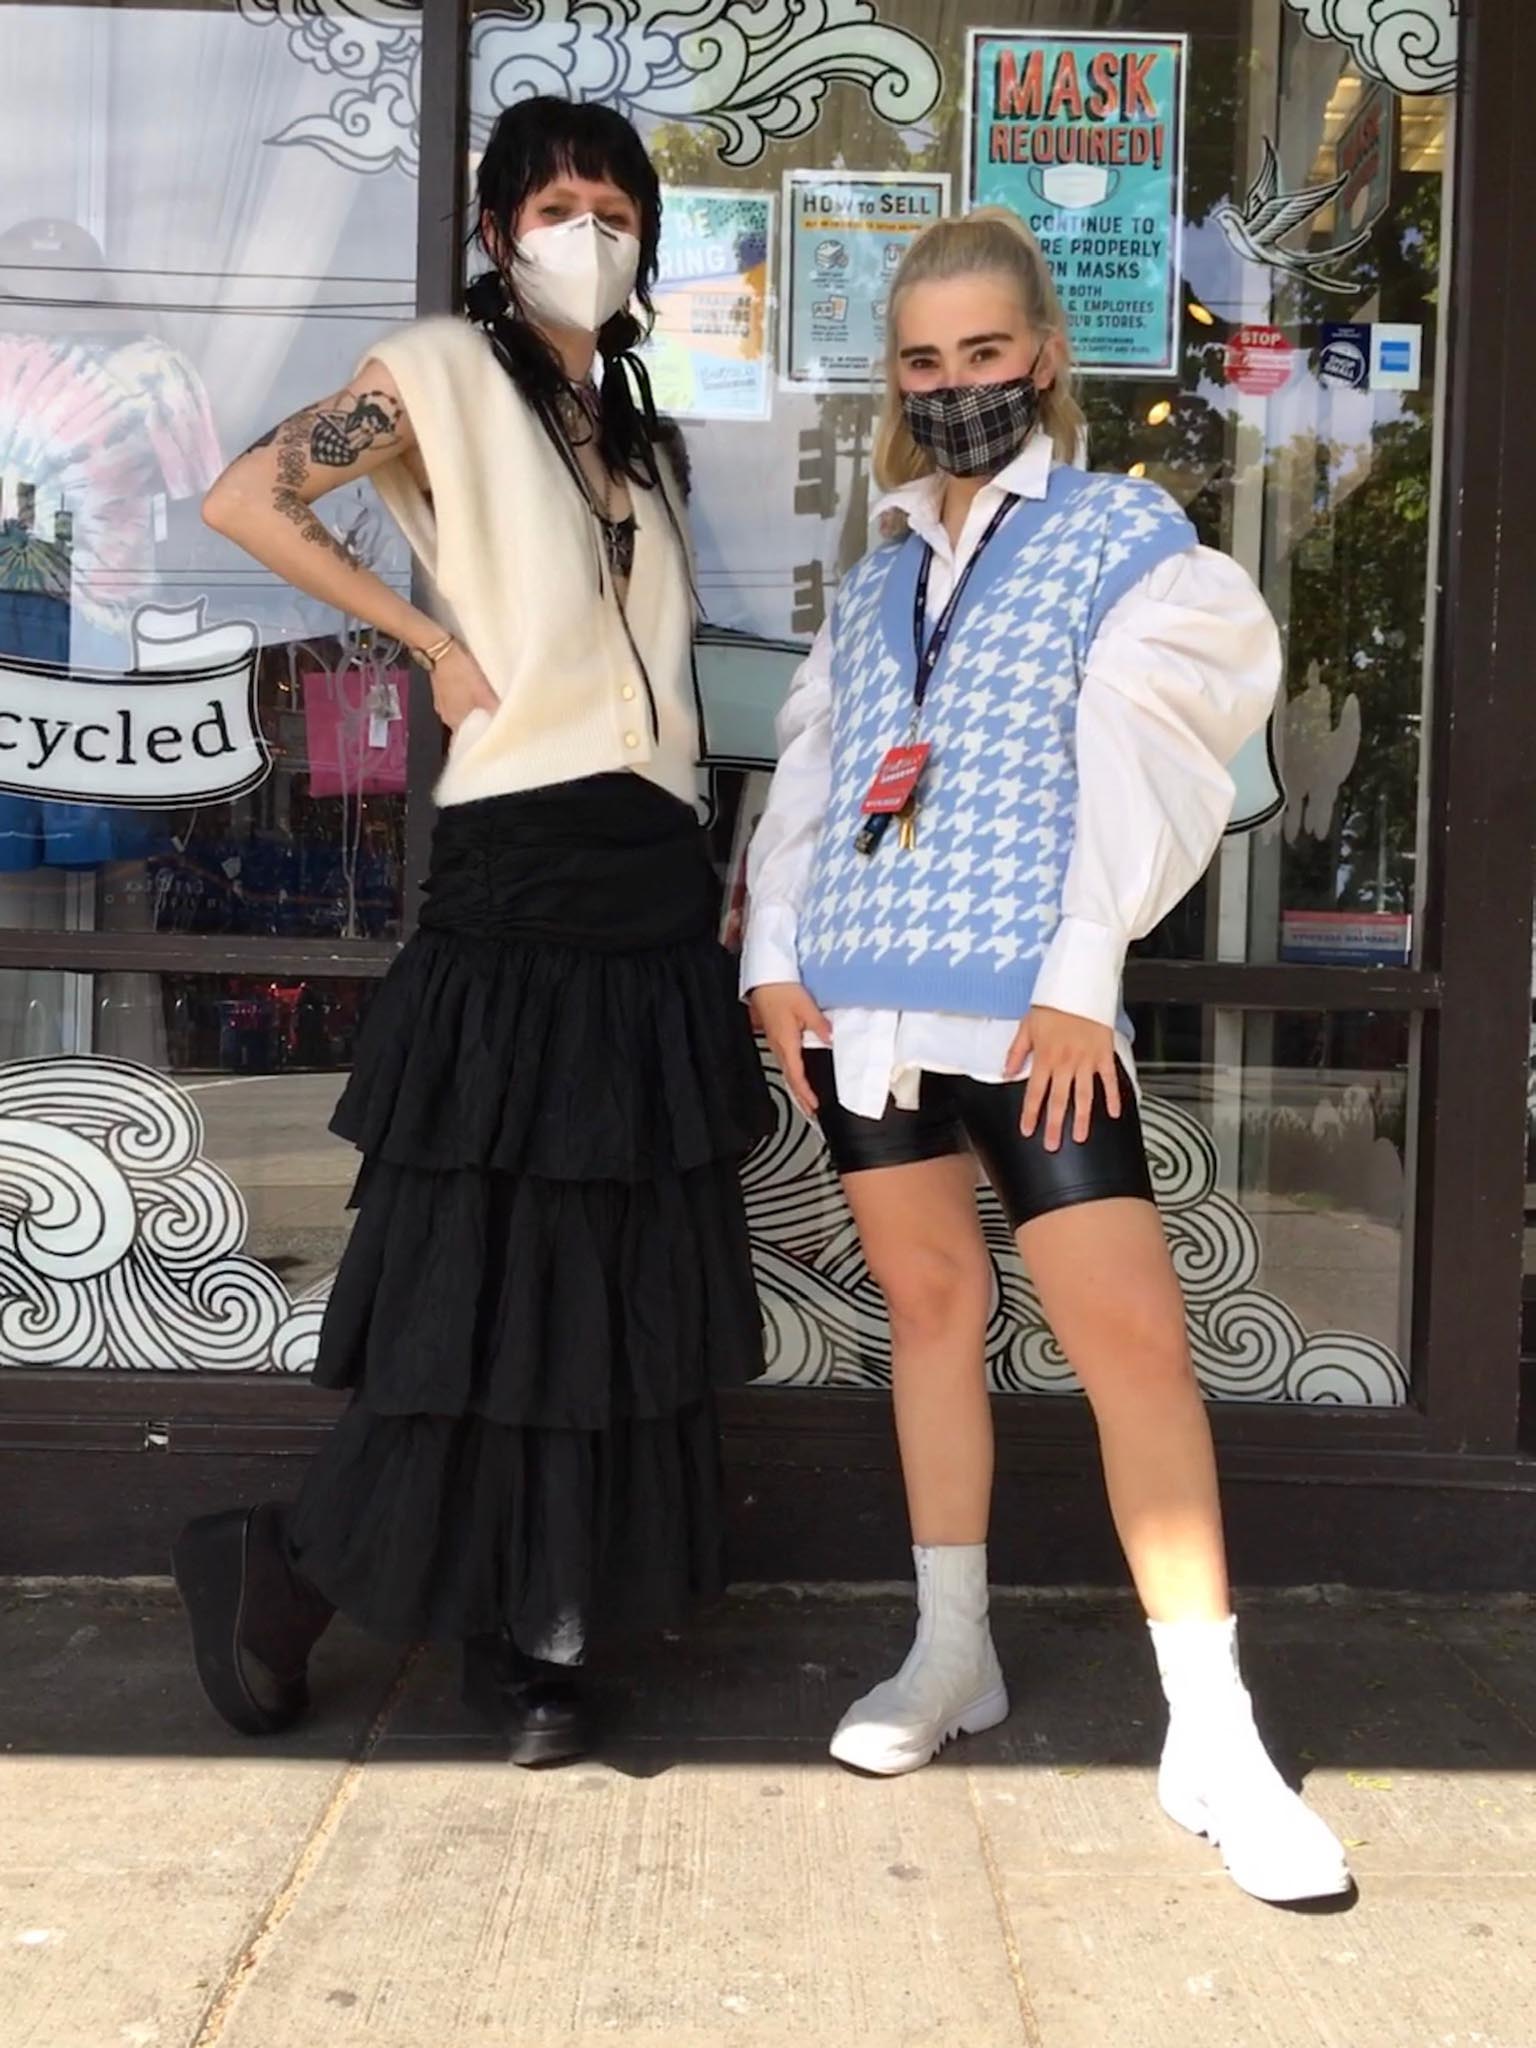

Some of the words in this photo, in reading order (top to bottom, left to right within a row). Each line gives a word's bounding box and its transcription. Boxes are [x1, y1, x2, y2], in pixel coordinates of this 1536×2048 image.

[994, 49, 1158, 121] MASK
[989, 123, 1164, 170] REQUIRED!
[880, 193, 931, 214] SELL
[1030, 215, 1123, 234] CONTINUE
[1132, 218, 1155, 234] TO
[1038, 239, 1063, 255] RE
[1070, 239, 1162, 258] PROPERLY
[658, 245, 726, 281] RING
[1077, 262, 1140, 279] MASKS
[1069, 285, 1102, 297] BOTH
[1084, 300, 1155, 313] EMPLOYEES
[1240, 331, 1282, 347] STOP
